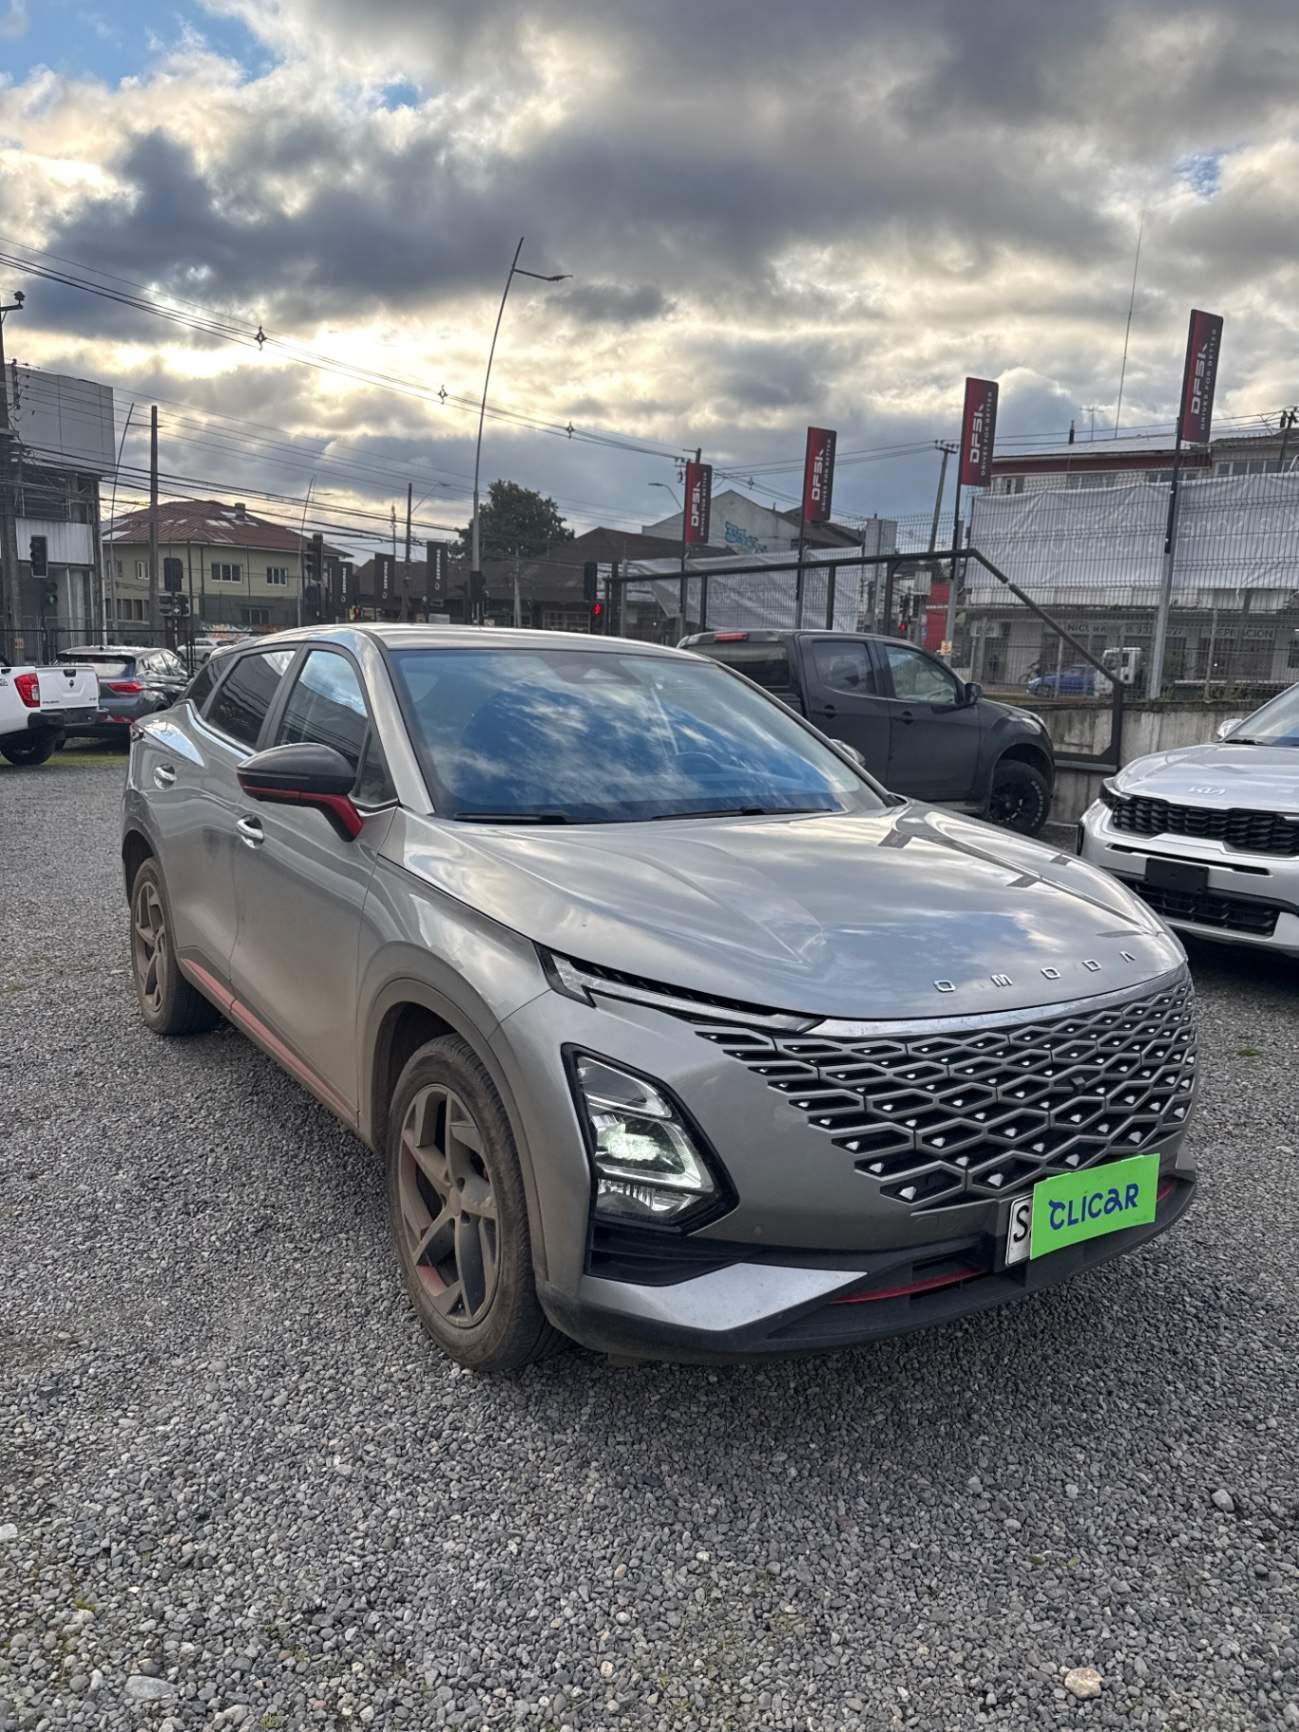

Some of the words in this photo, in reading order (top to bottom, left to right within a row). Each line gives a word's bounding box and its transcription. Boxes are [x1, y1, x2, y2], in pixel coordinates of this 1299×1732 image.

[1190, 343, 1208, 415] DFSK
[969, 403, 984, 464] DFSK
[811, 449, 824, 501] DFSK
[691, 481, 701, 528] DFSK
[934, 951, 1136, 993] OMODA
[1013, 1205, 1031, 1243] S
